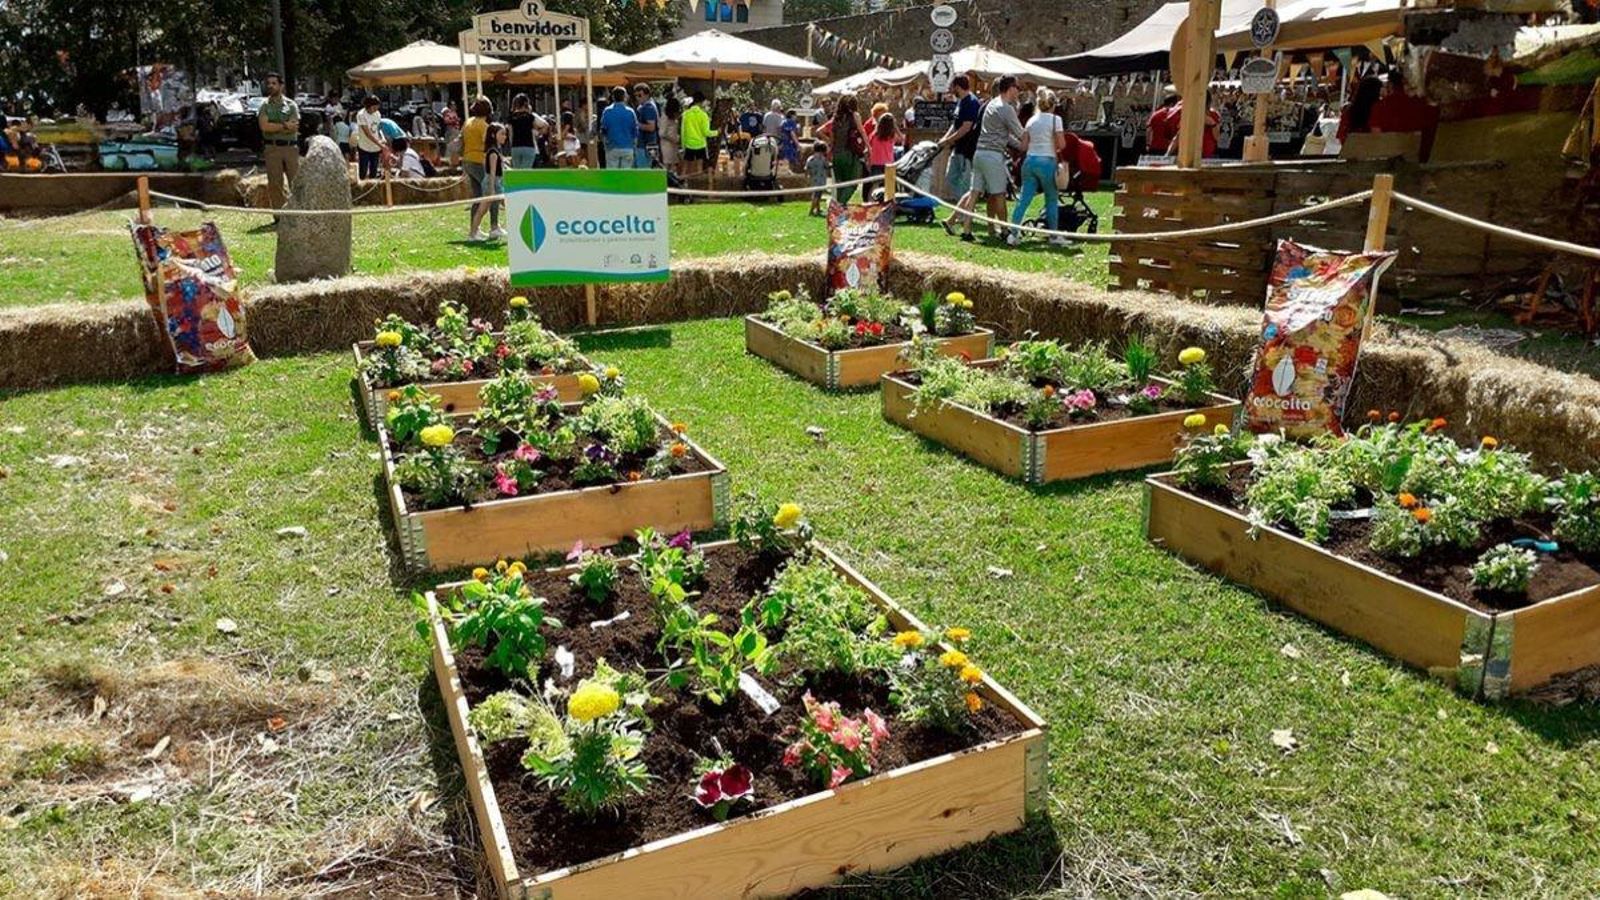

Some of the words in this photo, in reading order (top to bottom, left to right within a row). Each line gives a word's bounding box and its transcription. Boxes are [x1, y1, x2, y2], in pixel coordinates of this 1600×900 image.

[527, 3, 539, 16] R
[491, 20, 577, 36] benvidos!
[555, 215, 656, 235] ecocelta
